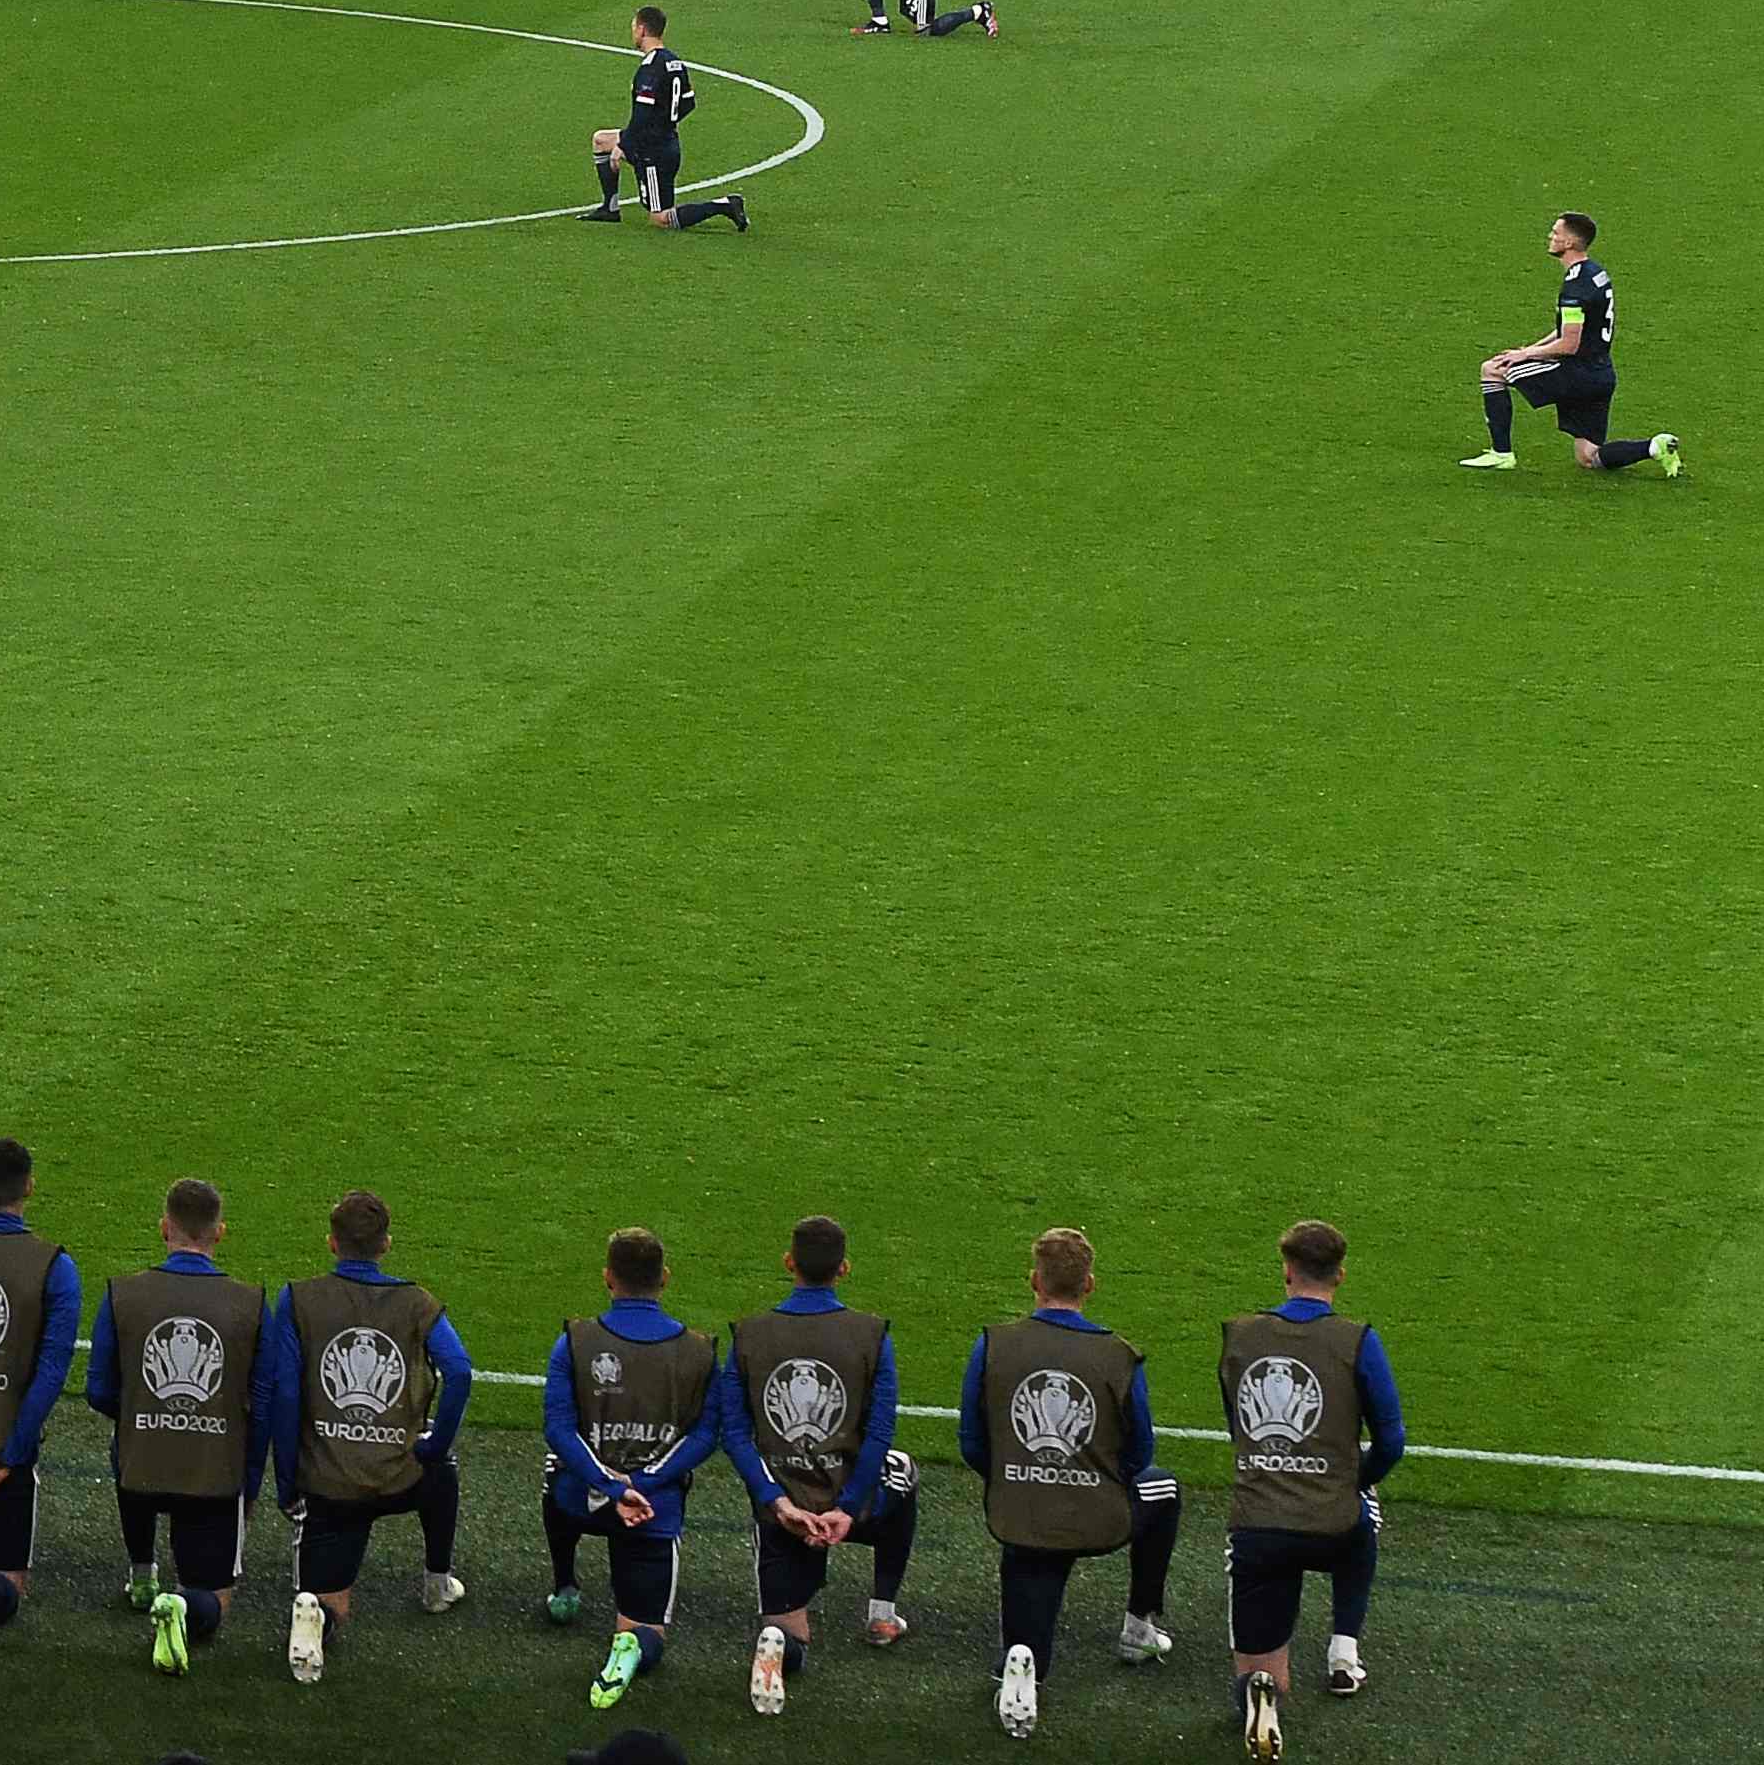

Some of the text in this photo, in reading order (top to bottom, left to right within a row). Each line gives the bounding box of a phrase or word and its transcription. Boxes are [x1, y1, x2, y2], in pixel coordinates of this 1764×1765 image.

[135, 1413, 227, 1434] EURO2020
[315, 1419, 407, 1445] EURO2020
[1004, 1463, 1100, 1487] EURO2020
